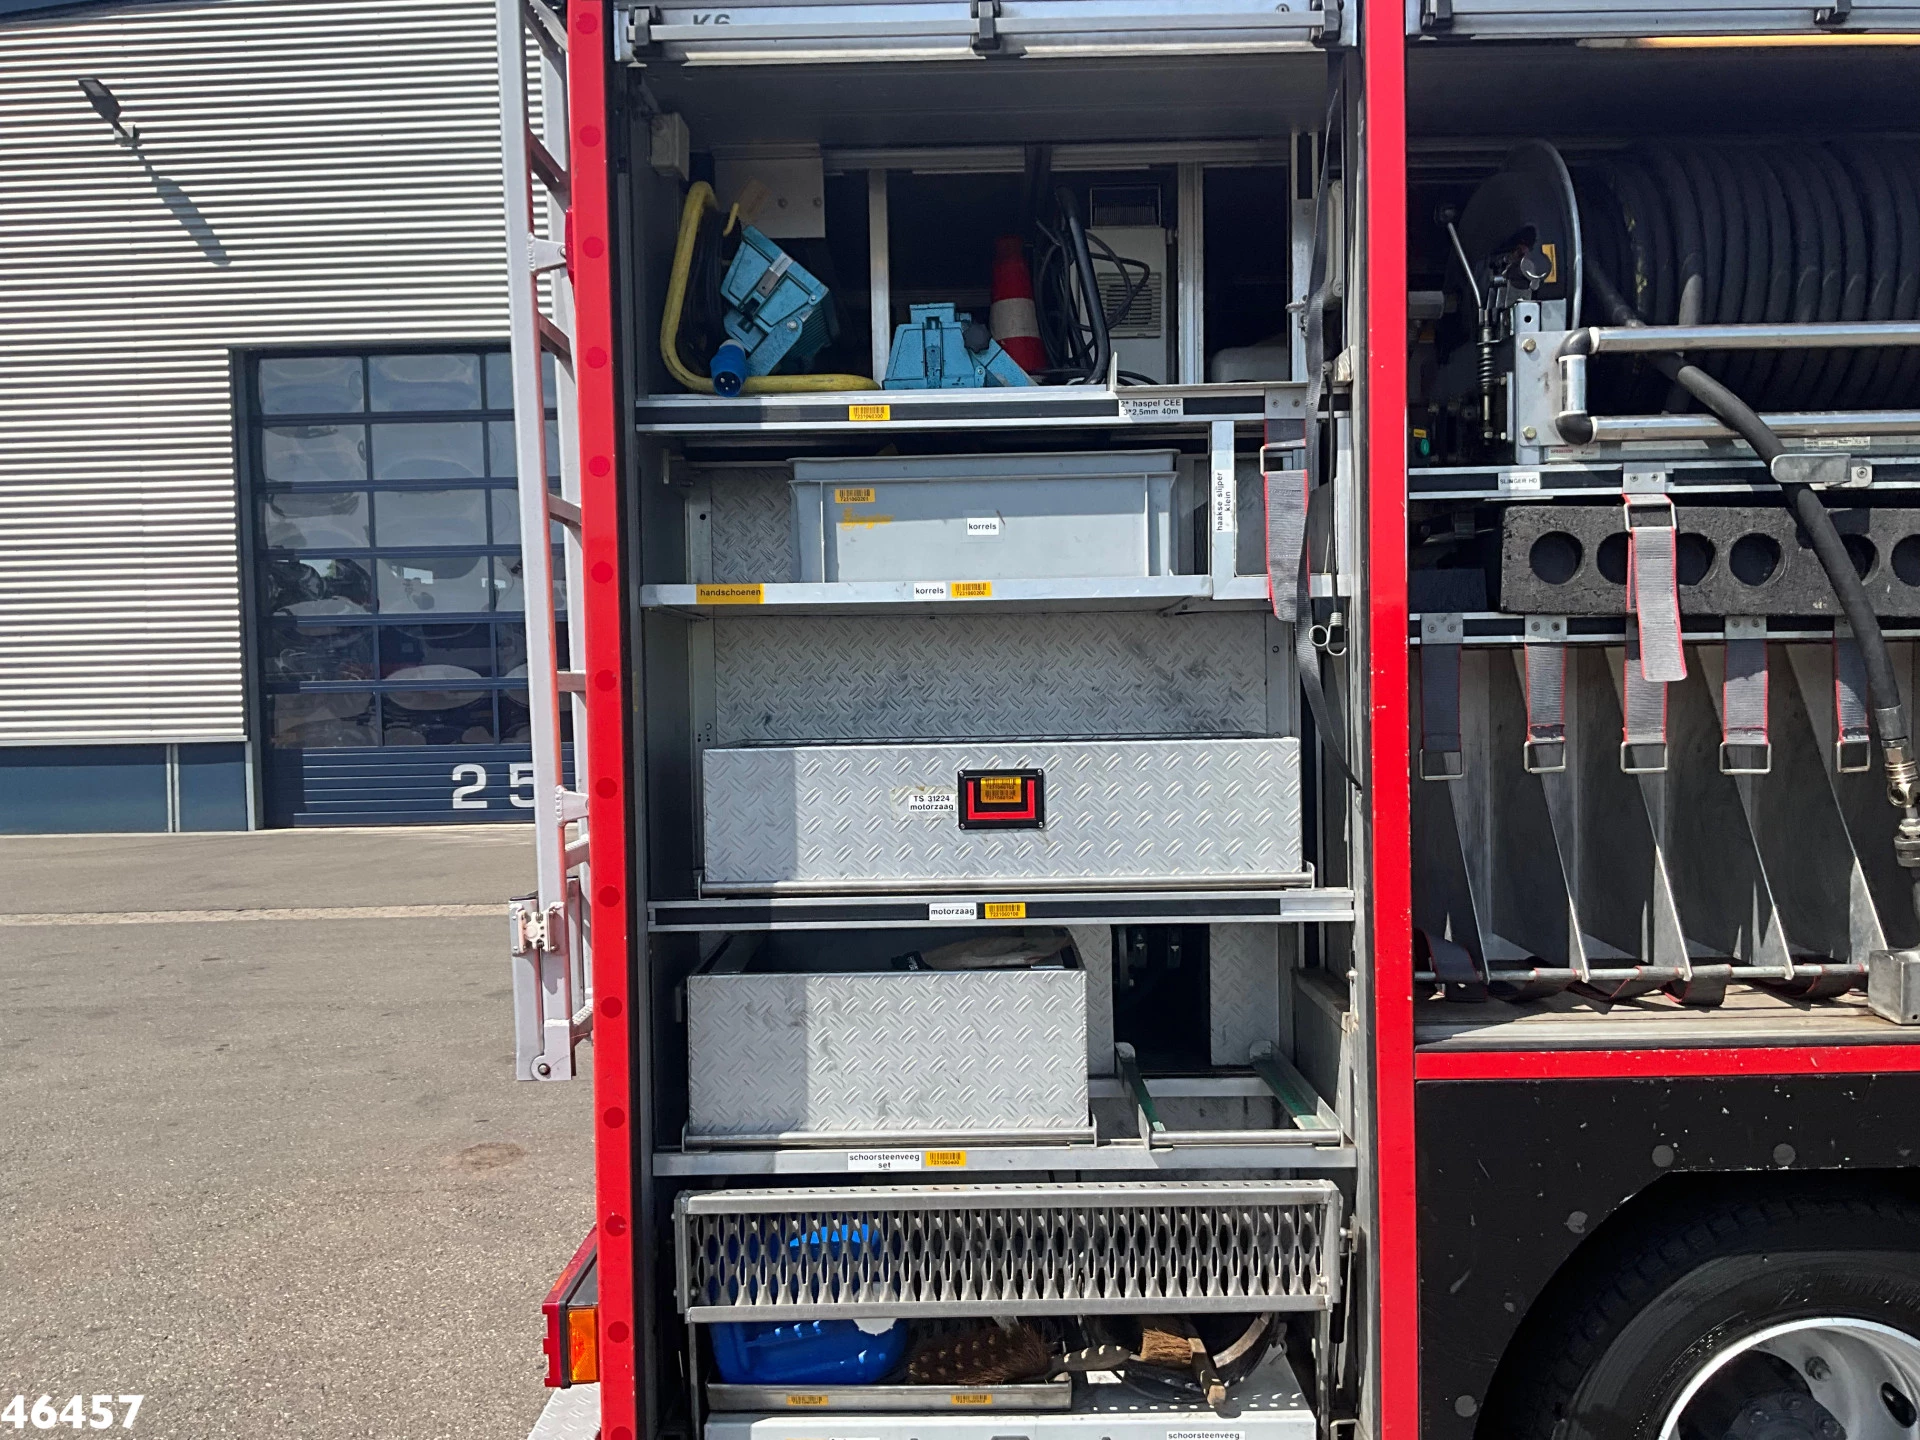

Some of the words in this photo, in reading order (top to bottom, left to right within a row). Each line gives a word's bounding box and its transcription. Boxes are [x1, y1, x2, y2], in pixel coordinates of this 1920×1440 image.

[1133, 400, 1160, 408] haspel
[1163, 399, 1181, 407] CEE
[1161, 407, 1179, 415] 40m
[700, 588, 761, 596] handschoenen
[931, 908, 975, 916] motorzaag
[849, 1153, 920, 1161] schoorsteenveeg
[1168, 1432, 1240, 1440] schoorsteenveeg
